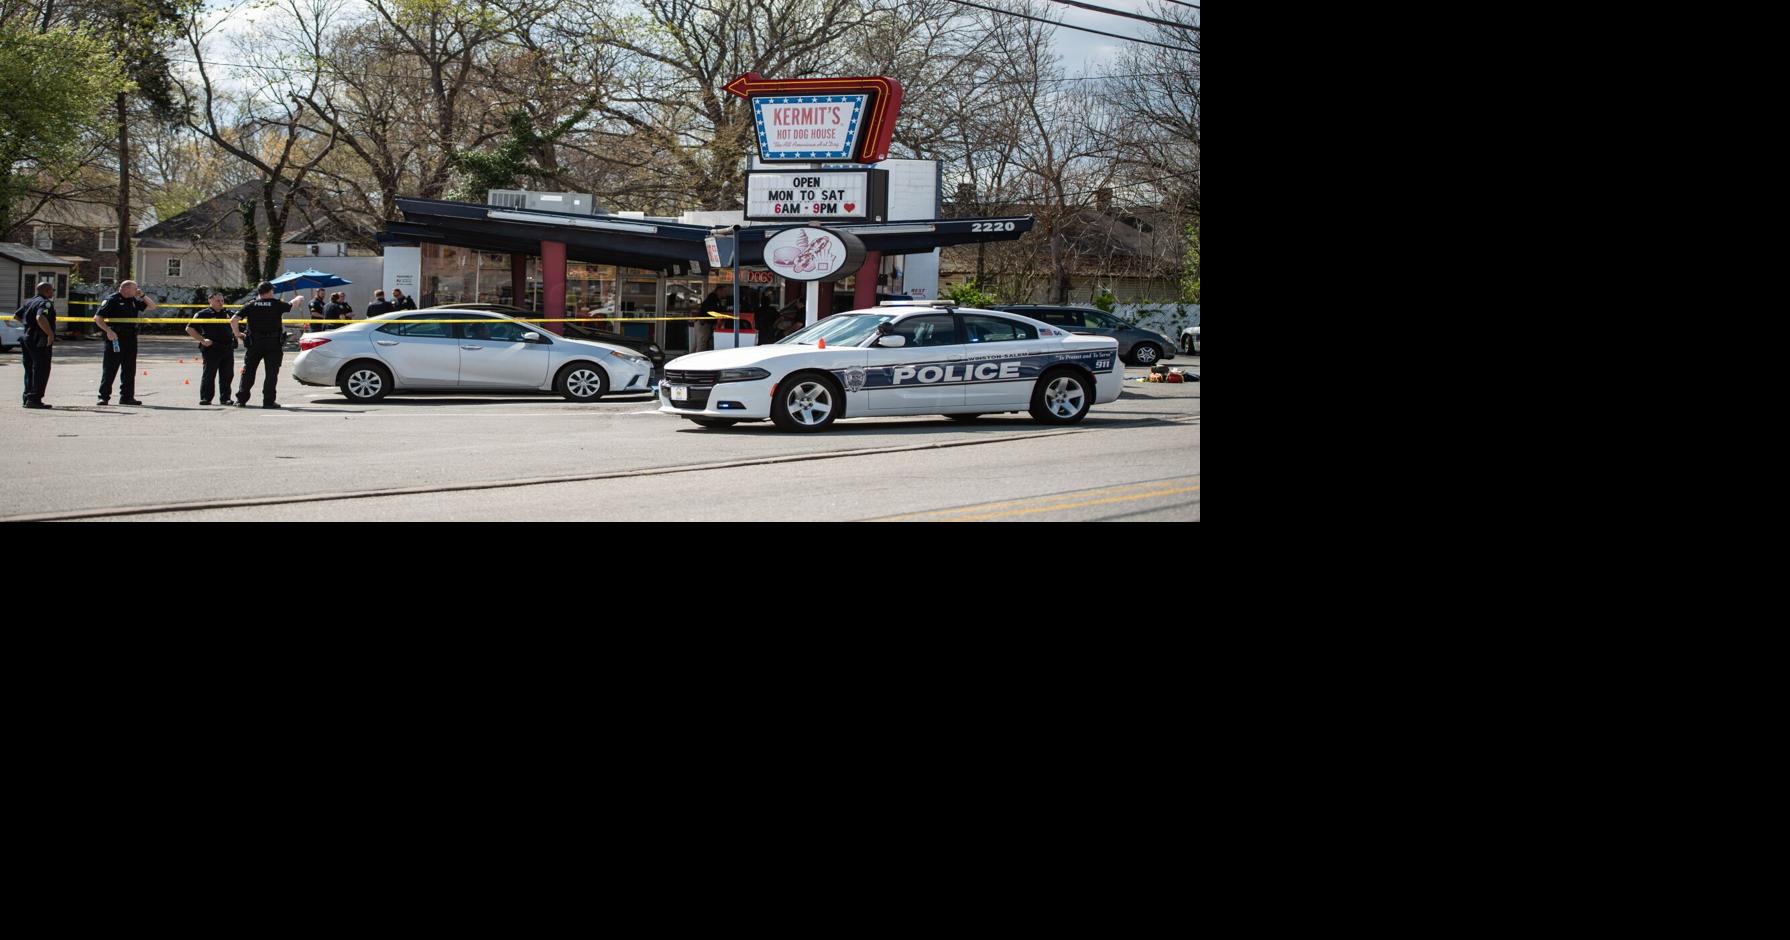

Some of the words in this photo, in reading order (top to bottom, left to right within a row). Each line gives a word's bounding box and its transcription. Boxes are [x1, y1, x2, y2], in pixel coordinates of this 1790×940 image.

[773, 106, 841, 126] KERMIT'S
[777, 129, 791, 140] HOT
[793, 129, 809, 140] DOG
[811, 128, 836, 139] HOUSE
[793, 177, 821, 188] OPEN
[768, 190, 793, 201] MON
[800, 190, 815, 201] TO
[821, 190, 845, 201] SAT
[774, 203, 800, 214] 6AM
[812, 203, 837, 214] 9PM
[971, 221, 1016, 233] 2220
[747, 270, 774, 284] DOGS
[967, 352, 1028, 361] WINSTON-SALEM
[1095, 360, 1110, 369] 911
[892, 361, 1022, 385] POLICE
